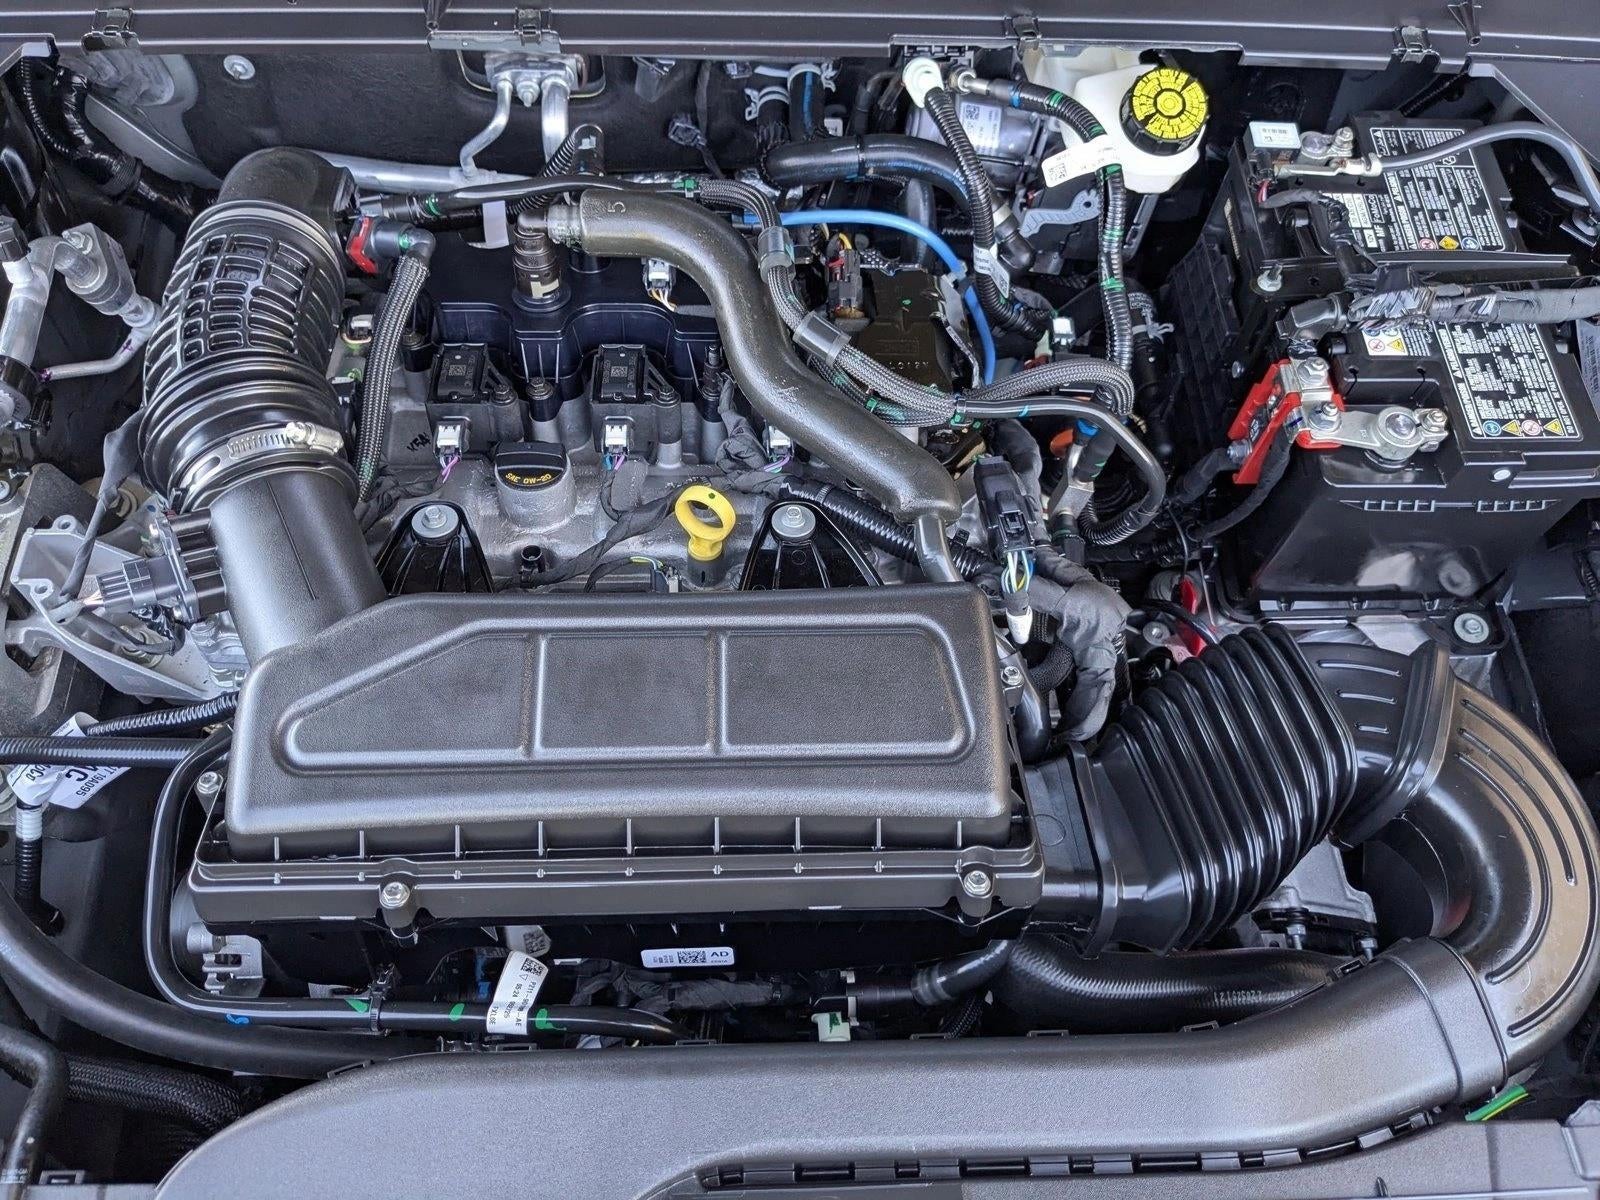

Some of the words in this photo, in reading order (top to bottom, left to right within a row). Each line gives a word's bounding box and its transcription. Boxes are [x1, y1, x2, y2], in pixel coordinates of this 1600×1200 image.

[1366, 195, 1381, 221] FoMoCo
[505, 472, 521, 483] SAE
[523, 473, 552, 485] 0W-20
[76, 774, 107, 797] 19A095
